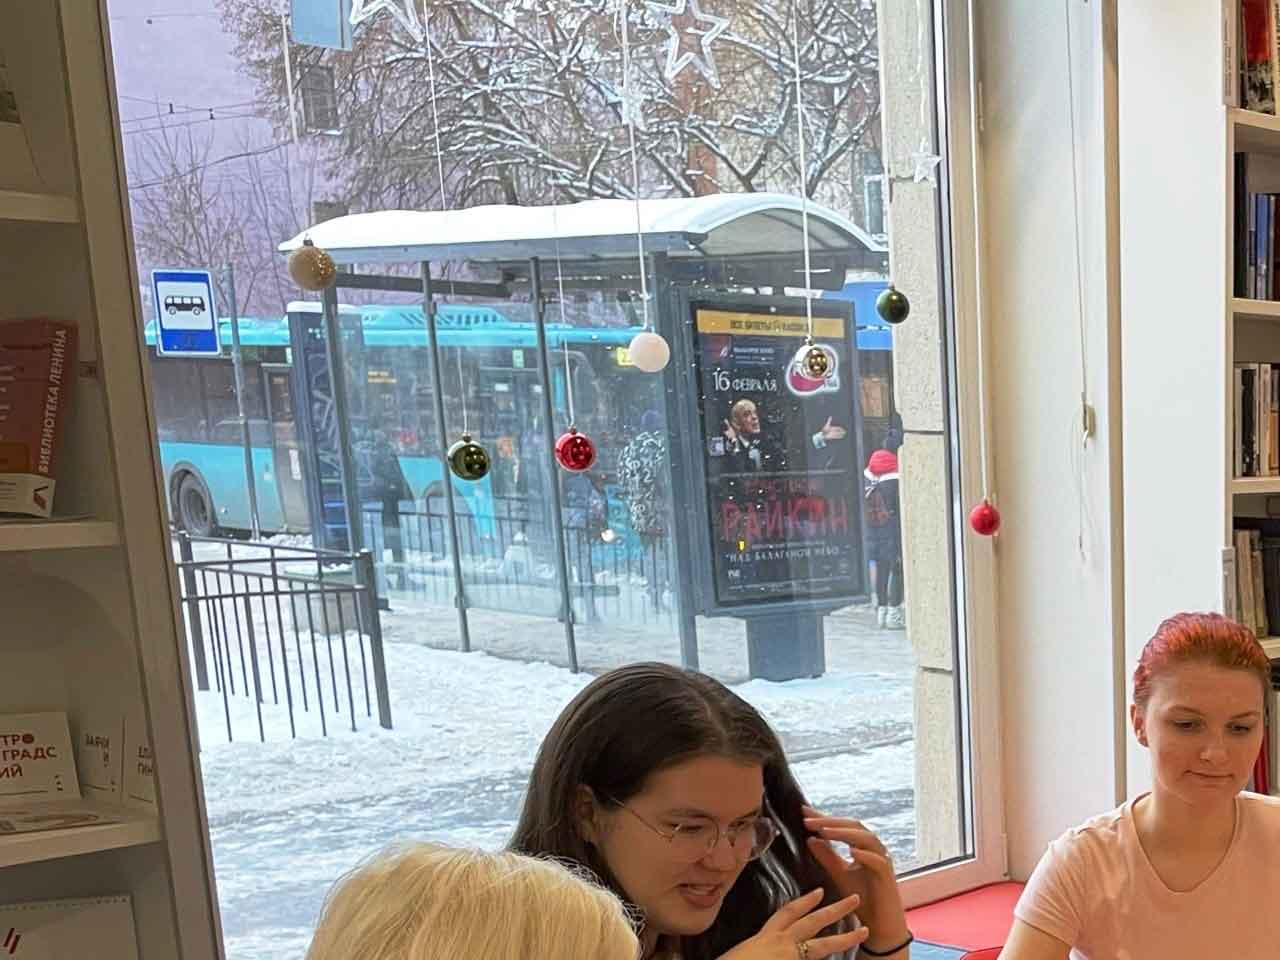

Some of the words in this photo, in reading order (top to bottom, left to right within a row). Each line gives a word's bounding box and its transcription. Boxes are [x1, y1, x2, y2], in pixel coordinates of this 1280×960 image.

[39, 386, 59, 473] БИБЛИОТЕКА
[49, 328, 66, 385] ЛЕНИНА
[712, 371, 730, 391] 16
[732, 377, 777, 392] ФЕВРАЛЯ
